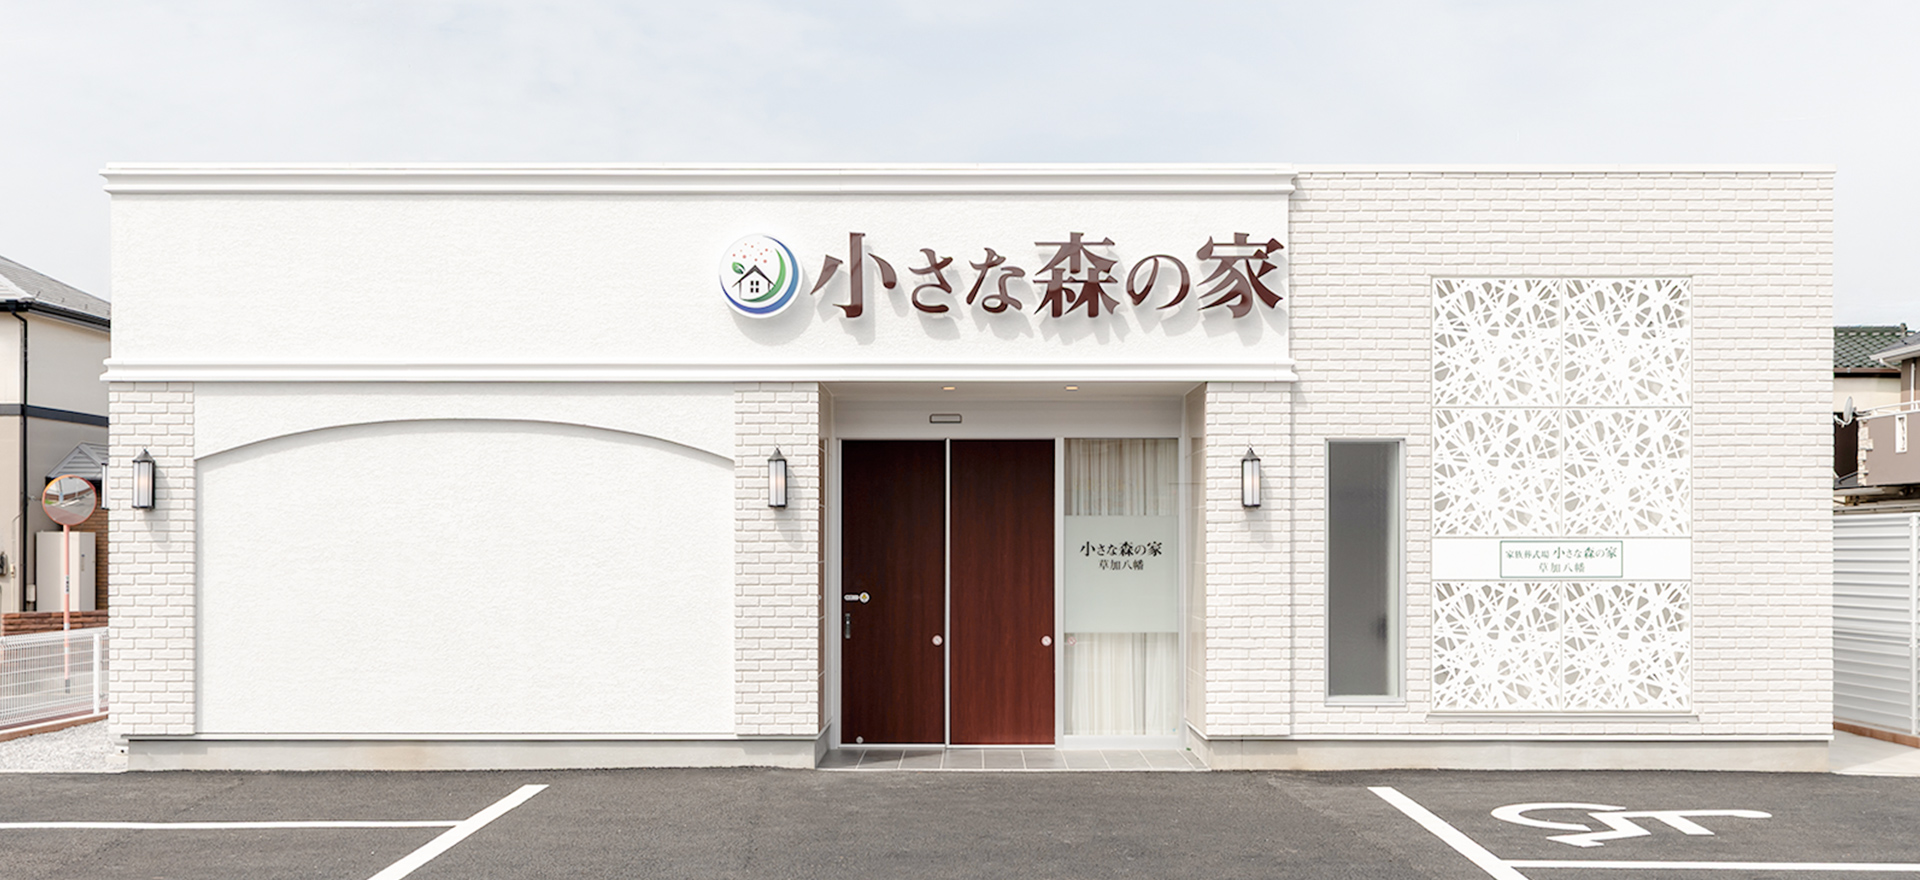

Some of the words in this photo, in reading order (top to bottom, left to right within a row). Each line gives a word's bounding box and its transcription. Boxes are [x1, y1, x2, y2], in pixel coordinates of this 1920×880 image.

[810, 232, 1285, 318] 小さな森の家
[1080, 541, 1162, 556] 小さな森の家
[1553, 546, 1617, 559] 小さな森の家
[1099, 559, 1144, 570] 草加八幡
[1539, 562, 1585, 573] 草加八幡
